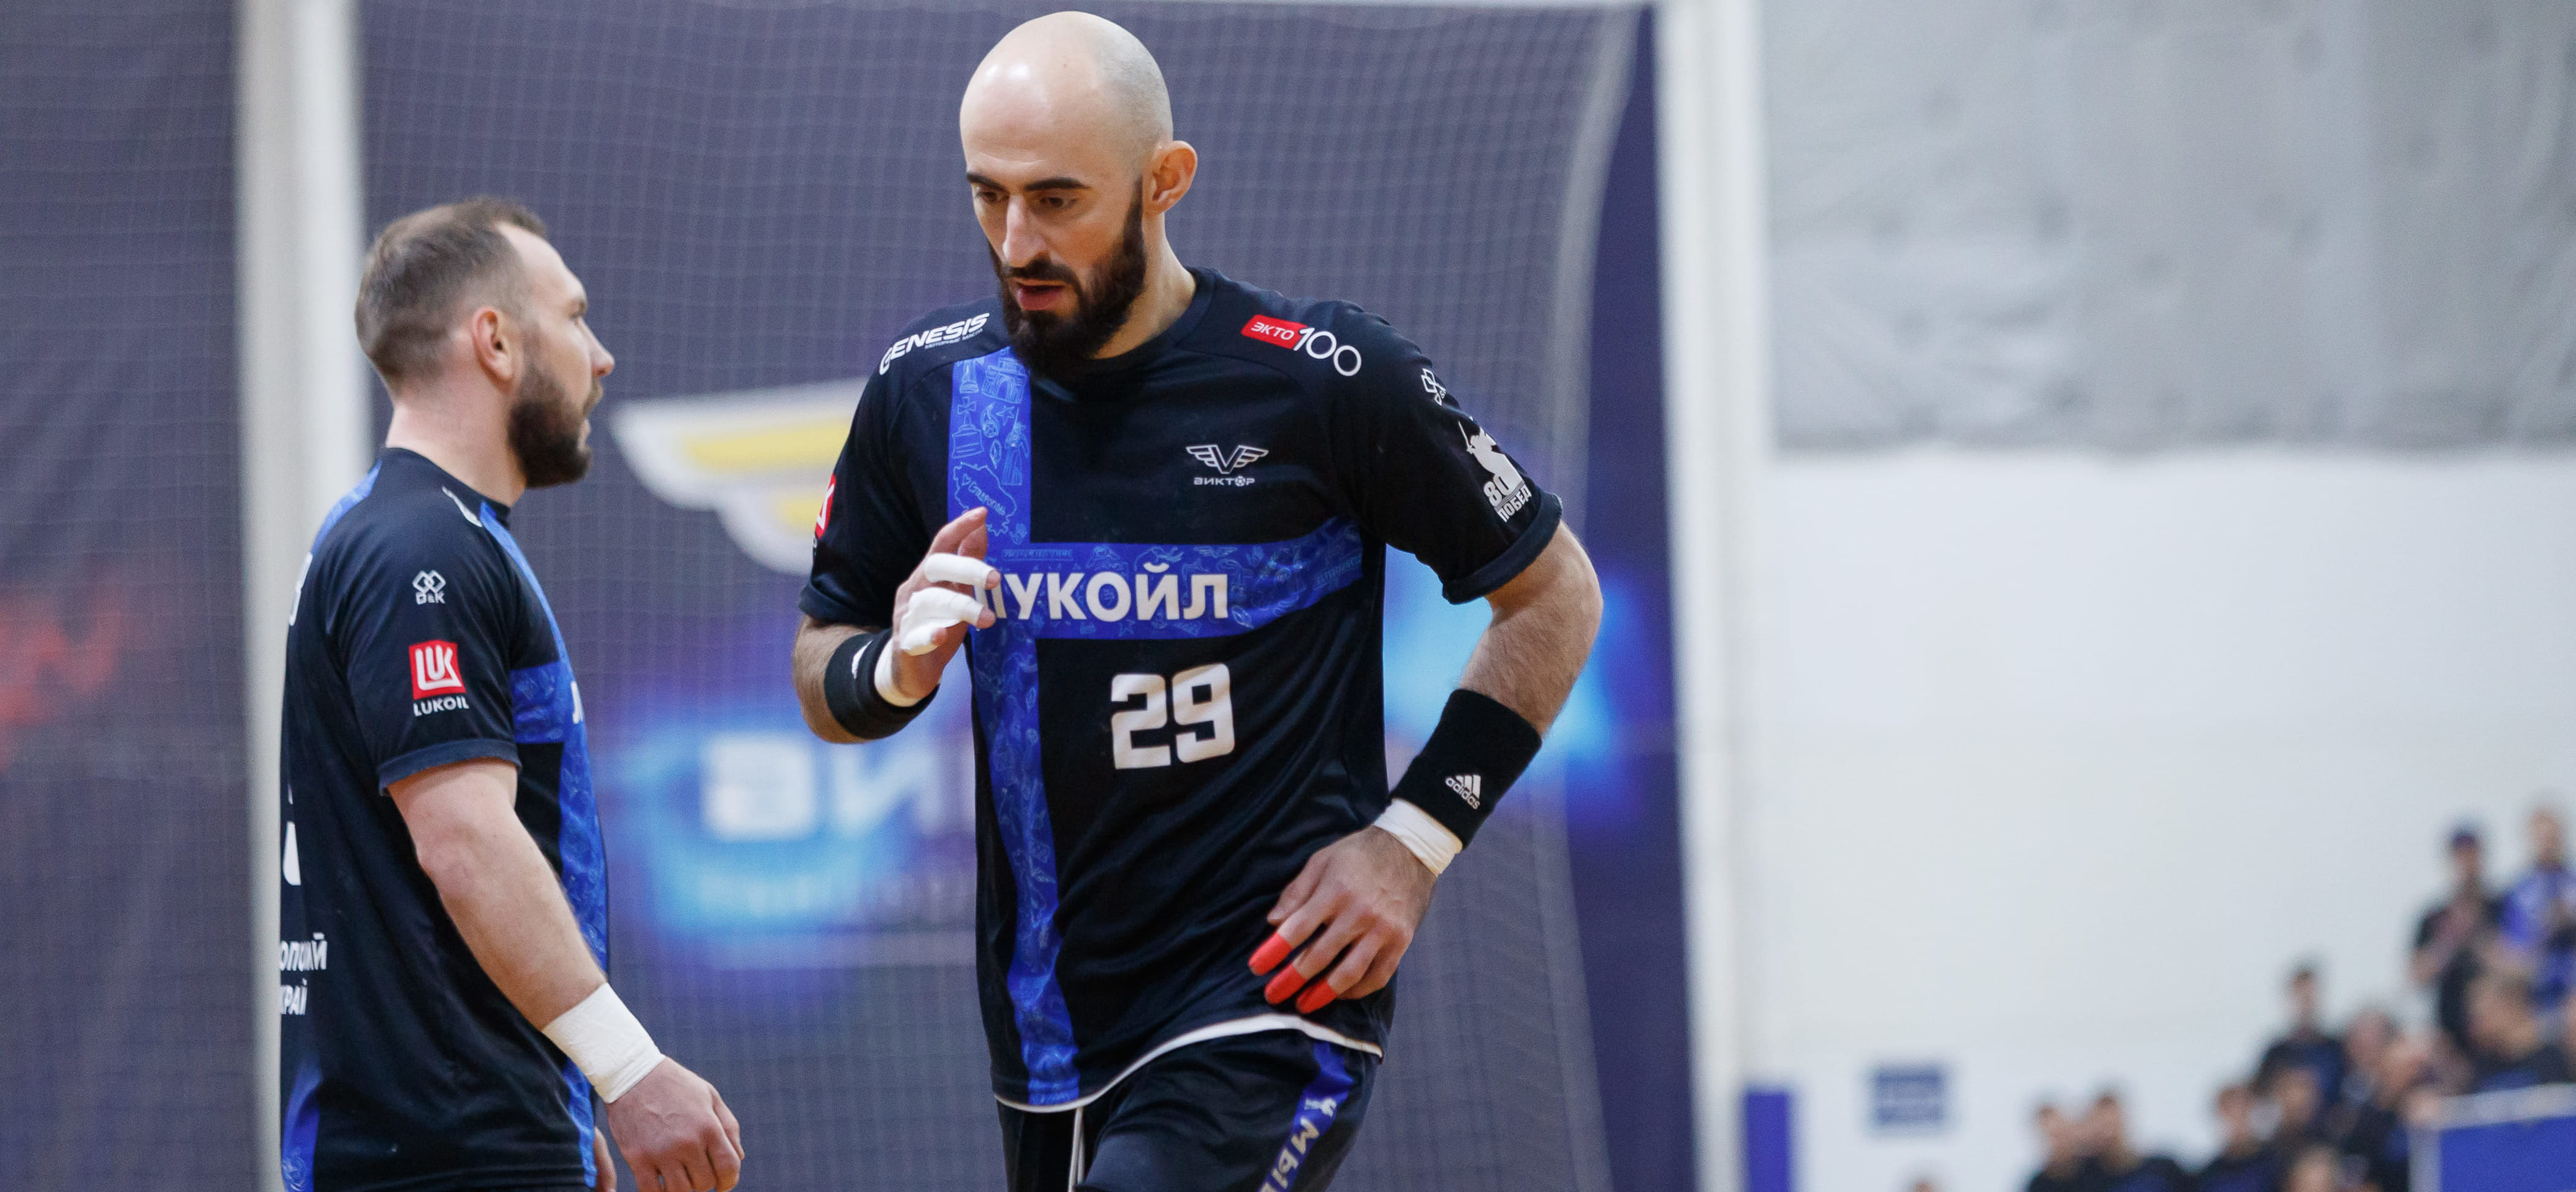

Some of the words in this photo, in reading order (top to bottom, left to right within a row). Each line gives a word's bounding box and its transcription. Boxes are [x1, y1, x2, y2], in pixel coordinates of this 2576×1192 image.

[879, 313, 990, 376] GENESIS
[1251, 322, 1295, 340] ЭКТО
[1293, 327, 1362, 376] 100
[1194, 476, 1255, 487] ВИКТОР
[1483, 474, 1512, 507] 80
[415, 590, 446, 605] D&K
[413, 695, 469, 716] LUKOIL
[1110, 662, 1235, 770] 29
[1445, 776, 1480, 810] adidas
